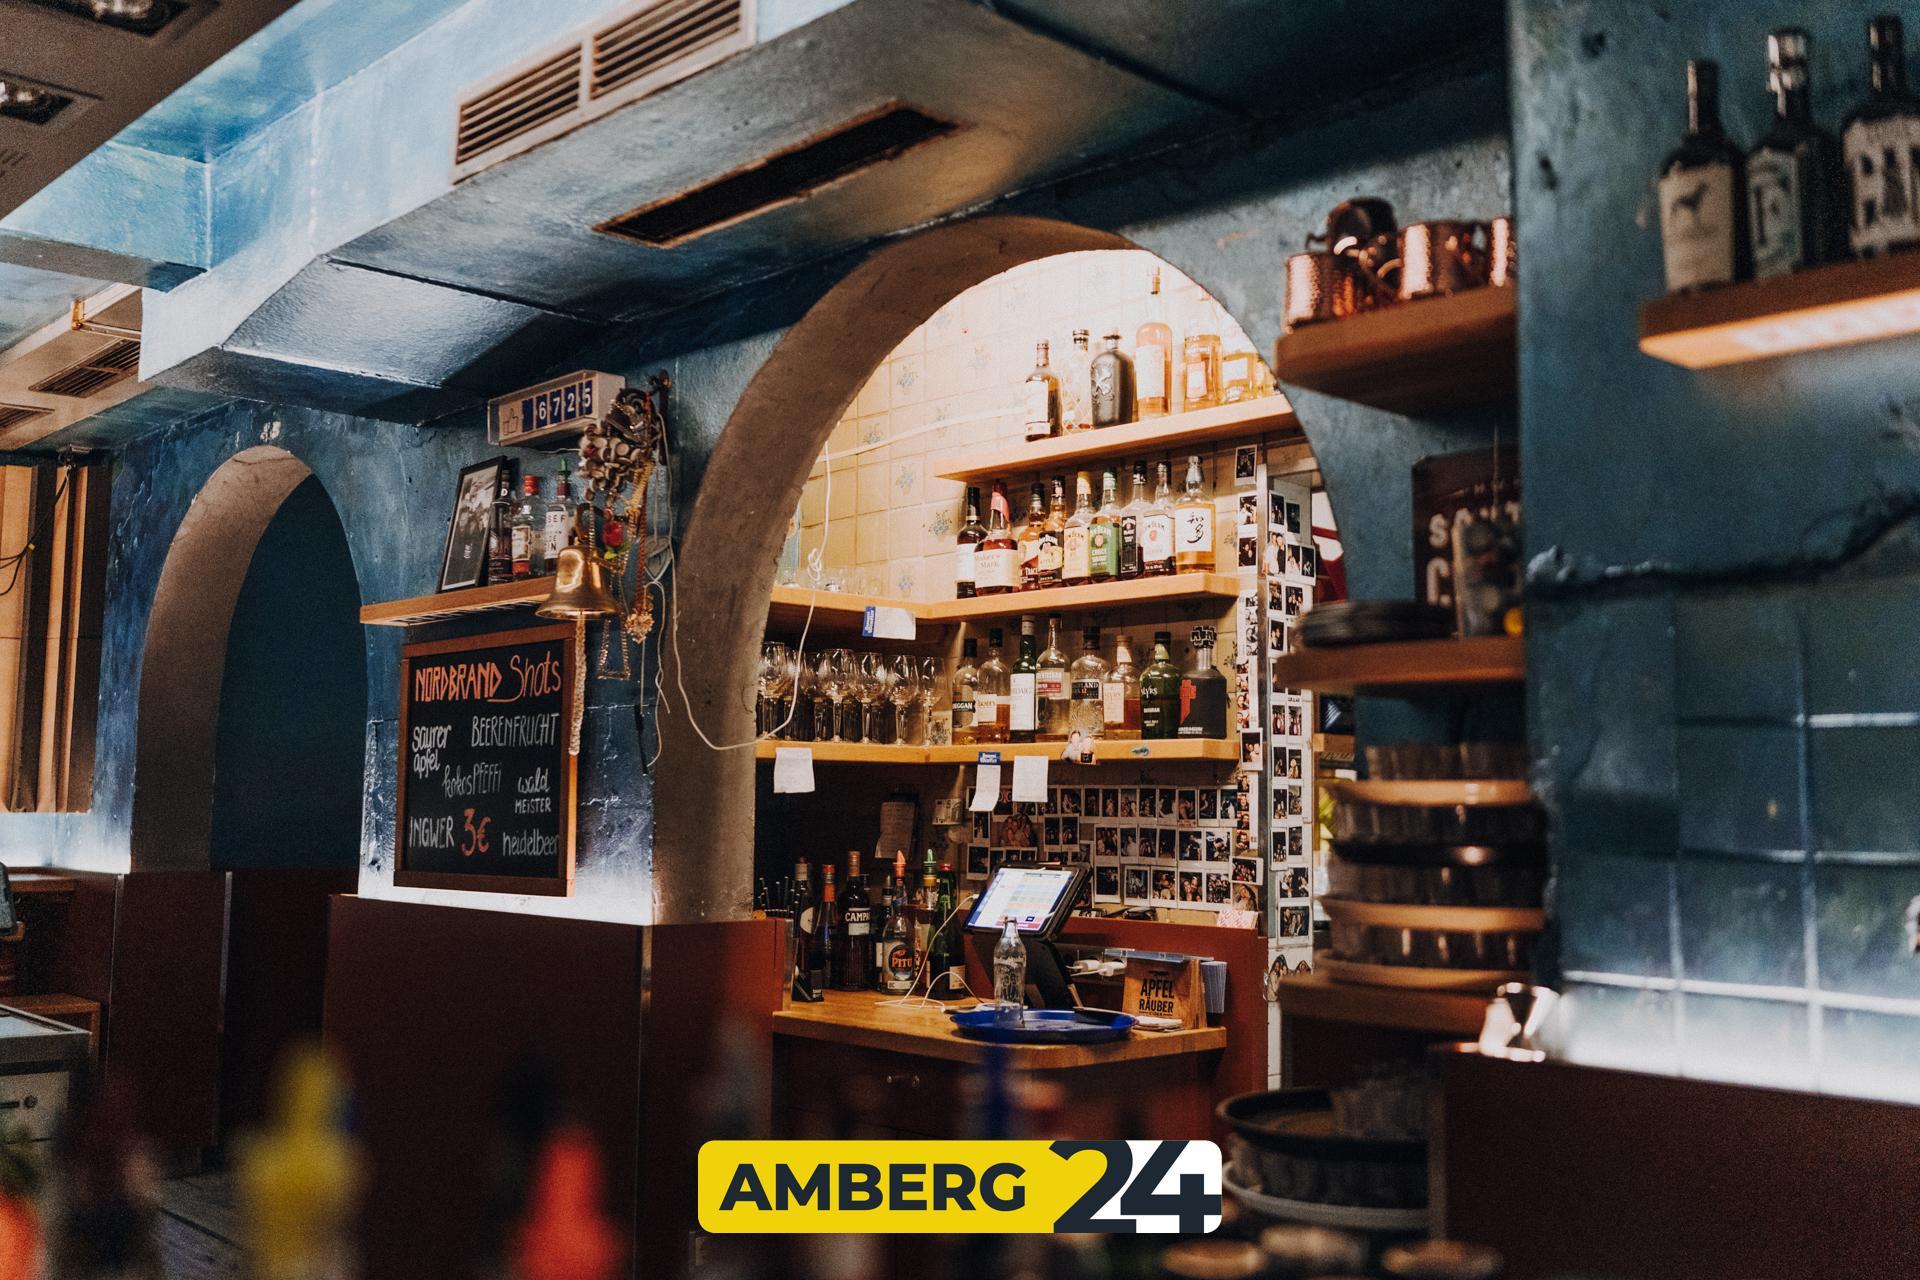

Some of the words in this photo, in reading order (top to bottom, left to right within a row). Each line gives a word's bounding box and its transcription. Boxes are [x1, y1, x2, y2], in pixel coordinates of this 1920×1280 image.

[538, 387, 592, 420] 6725
[415, 661, 503, 702] NORDBRAND
[487, 650, 562, 702] Shots
[411, 724, 452, 752] saurer
[471, 712, 560, 748] BEERENFRUCHT
[413, 747, 440, 779] apfel
[517, 766, 551, 794] wald
[409, 815, 455, 849] INGWER
[461, 807, 492, 857] 3€
[1139, 996, 1174, 1013] RÄUBER
[1140, 978, 1175, 999] APFEL
